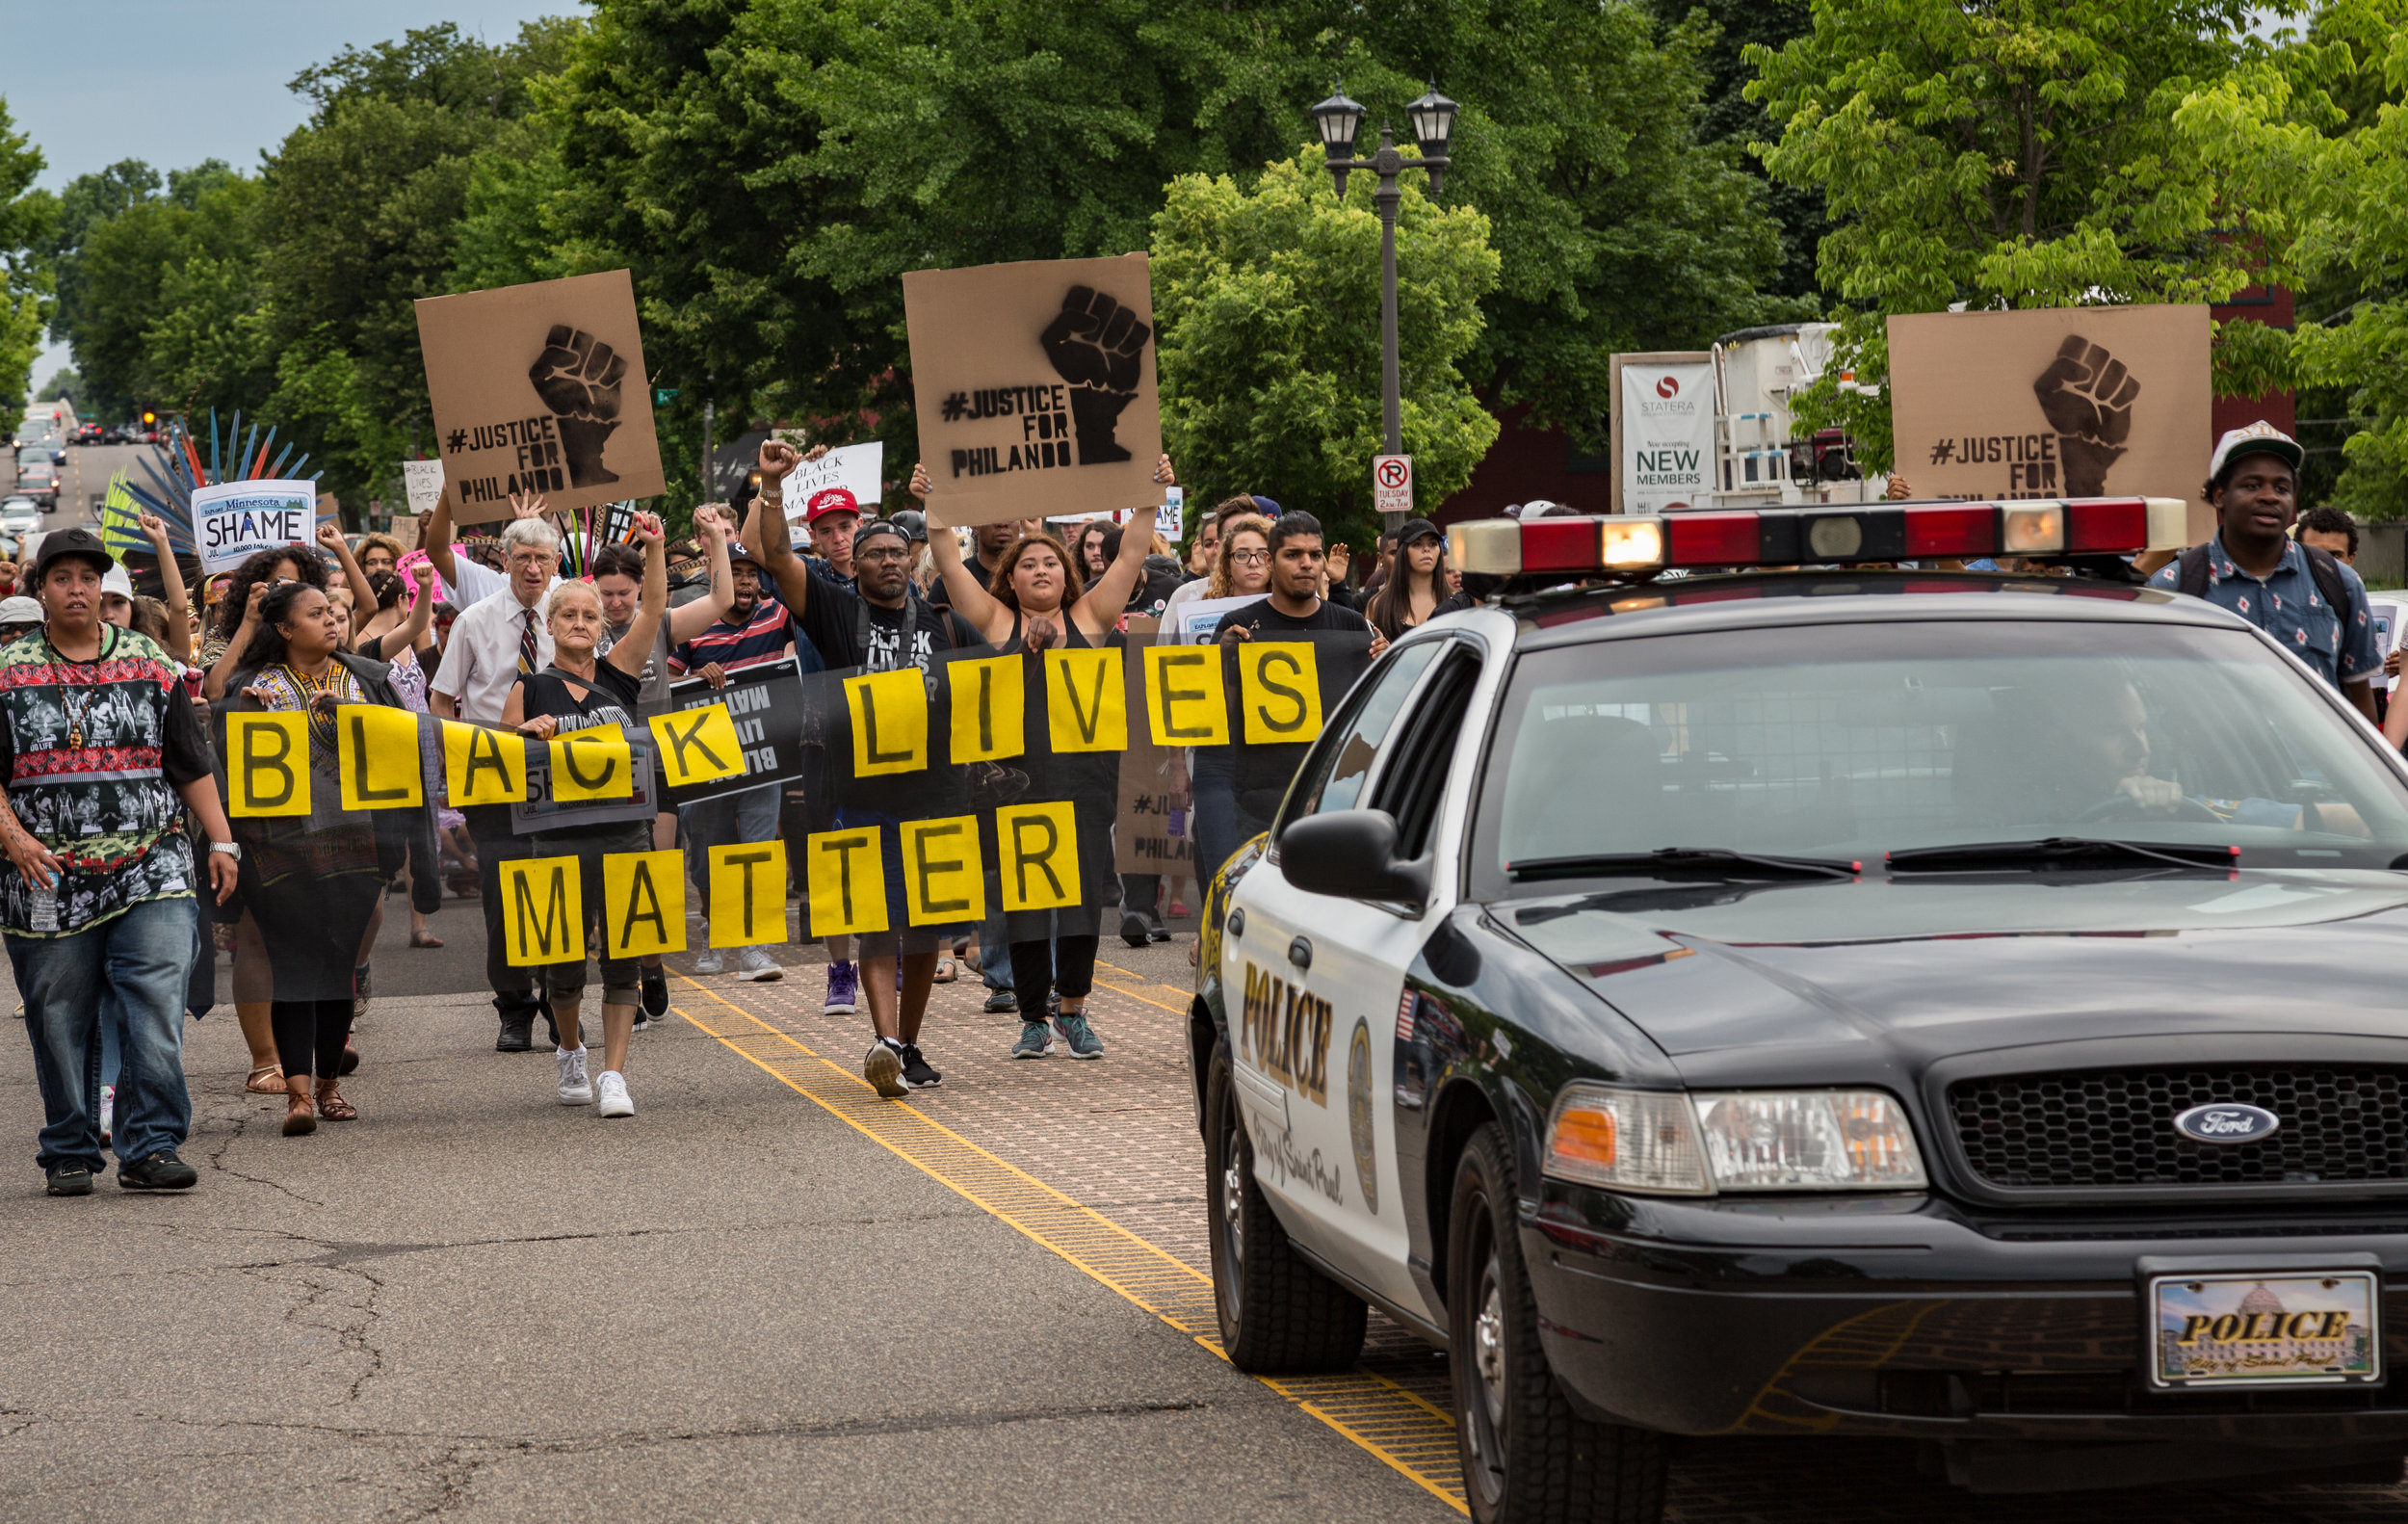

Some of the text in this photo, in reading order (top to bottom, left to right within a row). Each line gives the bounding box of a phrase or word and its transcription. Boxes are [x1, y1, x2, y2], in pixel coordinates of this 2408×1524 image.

[942, 384, 1066, 422] #JUSTICE
[1641, 401, 1695, 412] STATERA
[447, 415, 556, 454] #JUSTICE
[1023, 412, 1068, 441] FOR
[516, 441, 559, 470] FOR
[952, 440, 1071, 478] PHILANDO
[1636, 450, 1700, 472] NEW
[1929, 434, 2056, 464] #JUSTICE
[406, 465, 436, 475] #BLACK
[795, 455, 845, 481] BLACK
[797, 471, 840, 493] LIVES
[1637, 473, 1701, 486] MEMBERS
[2010, 462, 2056, 489] FOR
[410, 478, 433, 489] LIVES
[458, 467, 564, 503] PHILANDO
[1379, 489, 1408, 498] TUESDAY
[225, 498, 279, 512] Minnesota
[1157, 506, 1179, 524] AME
[206, 511, 301, 547] SHAME
[870, 622, 932, 655] BLAK
[867, 647, 929, 675] LIVS
[243, 714, 729, 807] BLACK
[859, 650, 1308, 764] LIVES
[736, 718, 766, 746] LIV
[1135, 836, 1193, 860] PHILA
[512, 814, 1066, 958] MATTER
[1241, 960, 1333, 1110] POLICE
[2200, 1111, 2254, 1134] Ford
[1253, 1111, 1275, 1181] City
[1282, 1130, 1314, 1192] Saint
[2177, 1310, 2350, 1346] POLICE
[2185, 1353, 2337, 1373] City of Saint Paul
